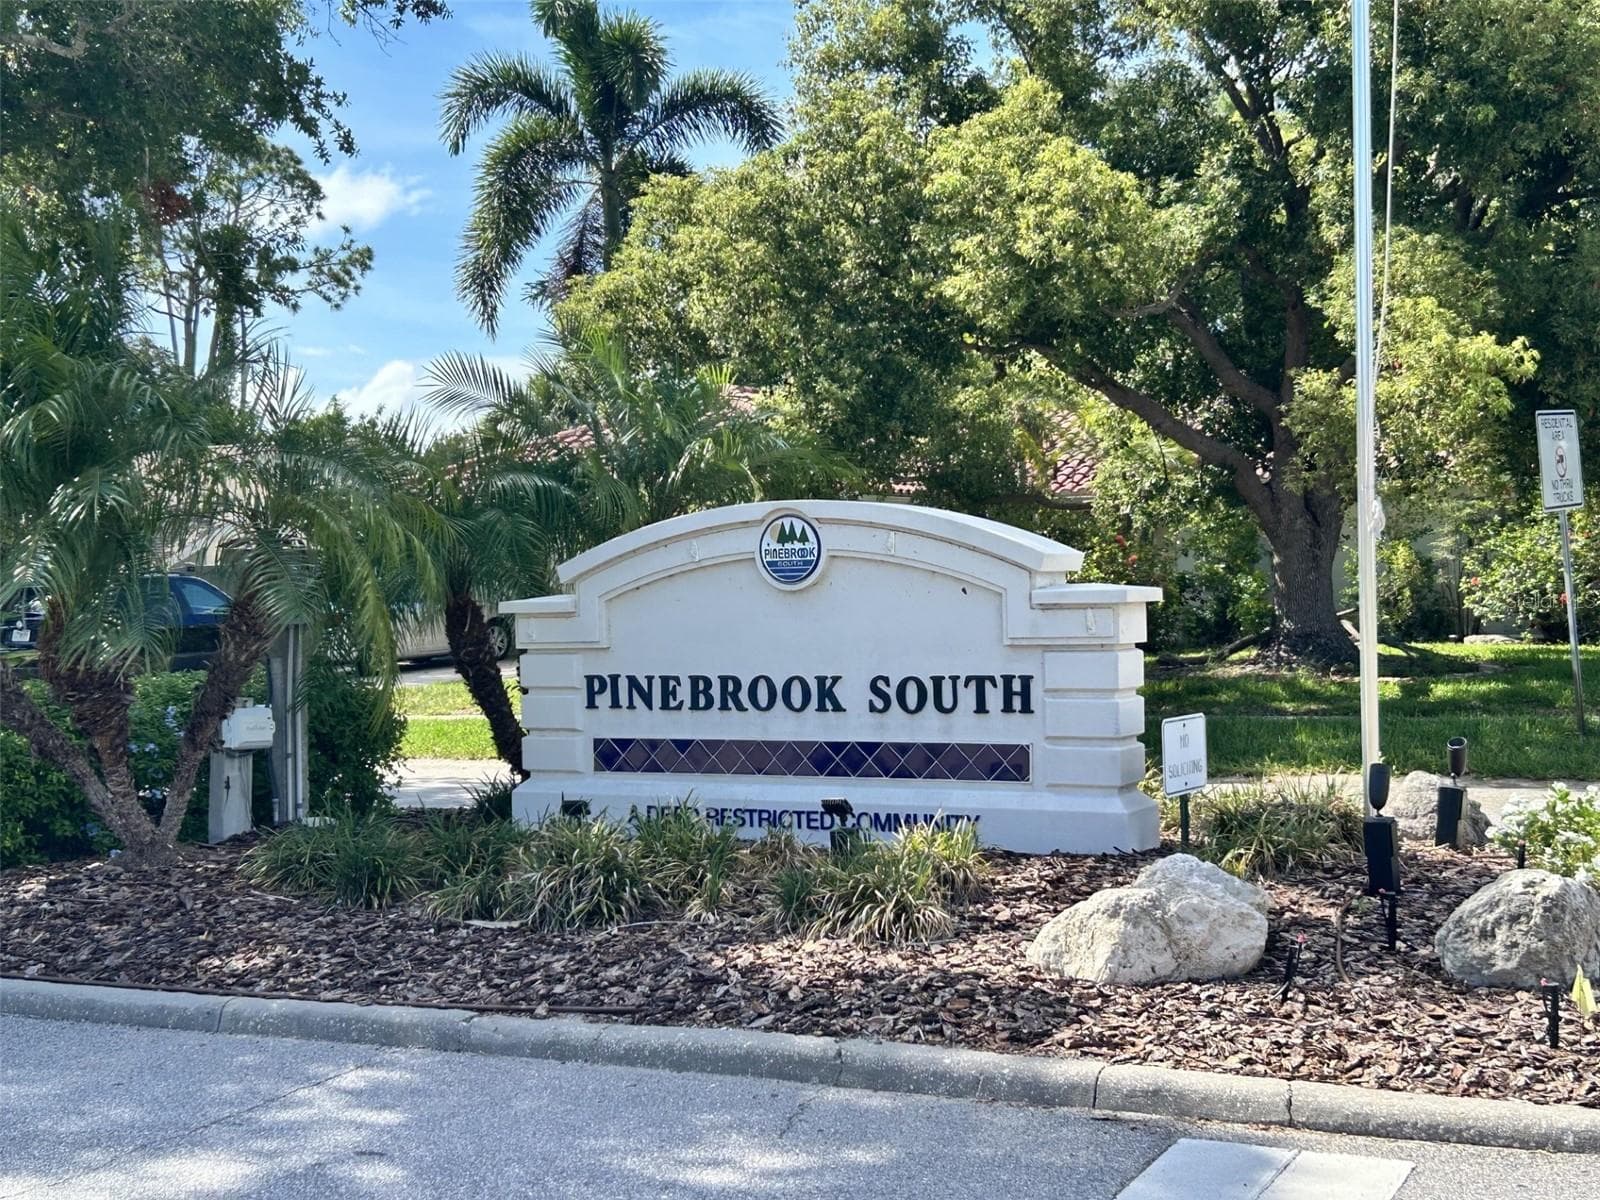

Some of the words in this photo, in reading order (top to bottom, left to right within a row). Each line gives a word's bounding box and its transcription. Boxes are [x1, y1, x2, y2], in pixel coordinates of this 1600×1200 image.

[585, 674, 847, 712] PINEBROOK
[869, 675, 1033, 715] SOUTH
[1179, 733, 1189, 750] NO
[705, 805, 834, 830] RESTRICTED
[845, 810, 981, 832] COMMUNITY
